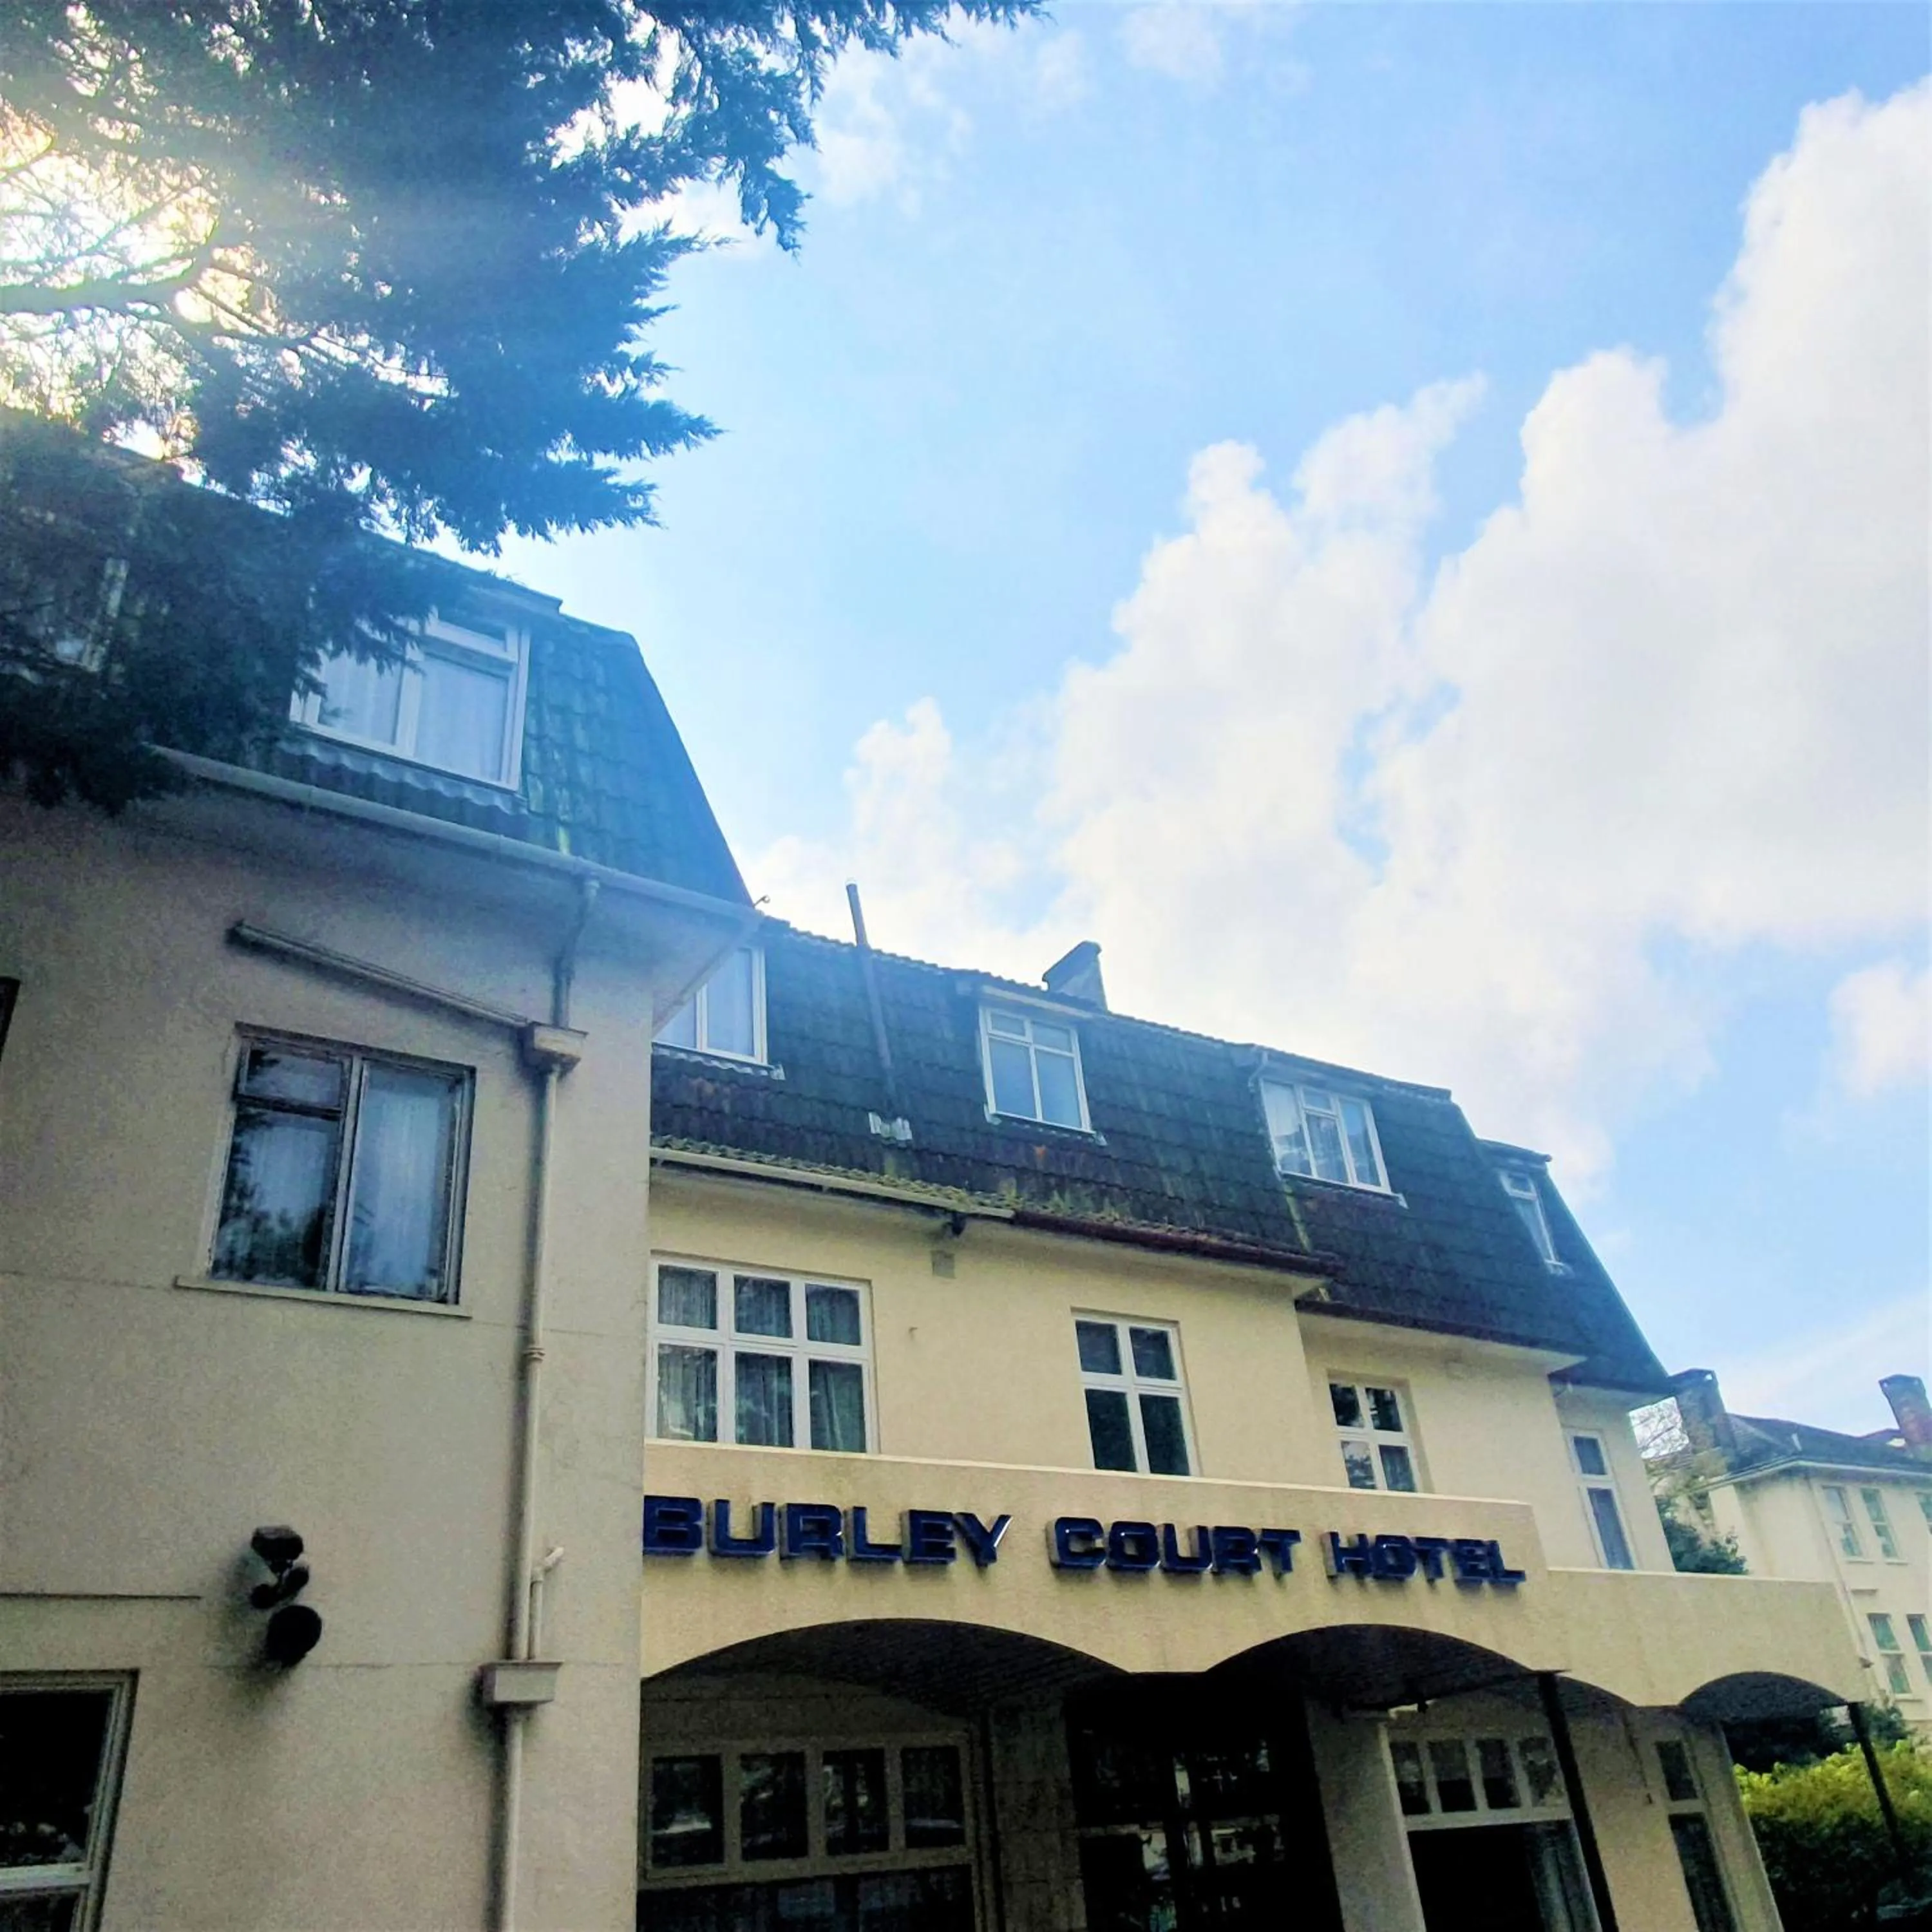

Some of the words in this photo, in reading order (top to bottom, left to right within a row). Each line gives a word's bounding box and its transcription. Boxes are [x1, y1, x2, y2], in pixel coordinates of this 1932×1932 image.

[643, 1495, 1011, 1566] BURLEY
[1046, 1517, 1302, 1575] COURT
[1323, 1531, 1526, 1586] HOTEL
